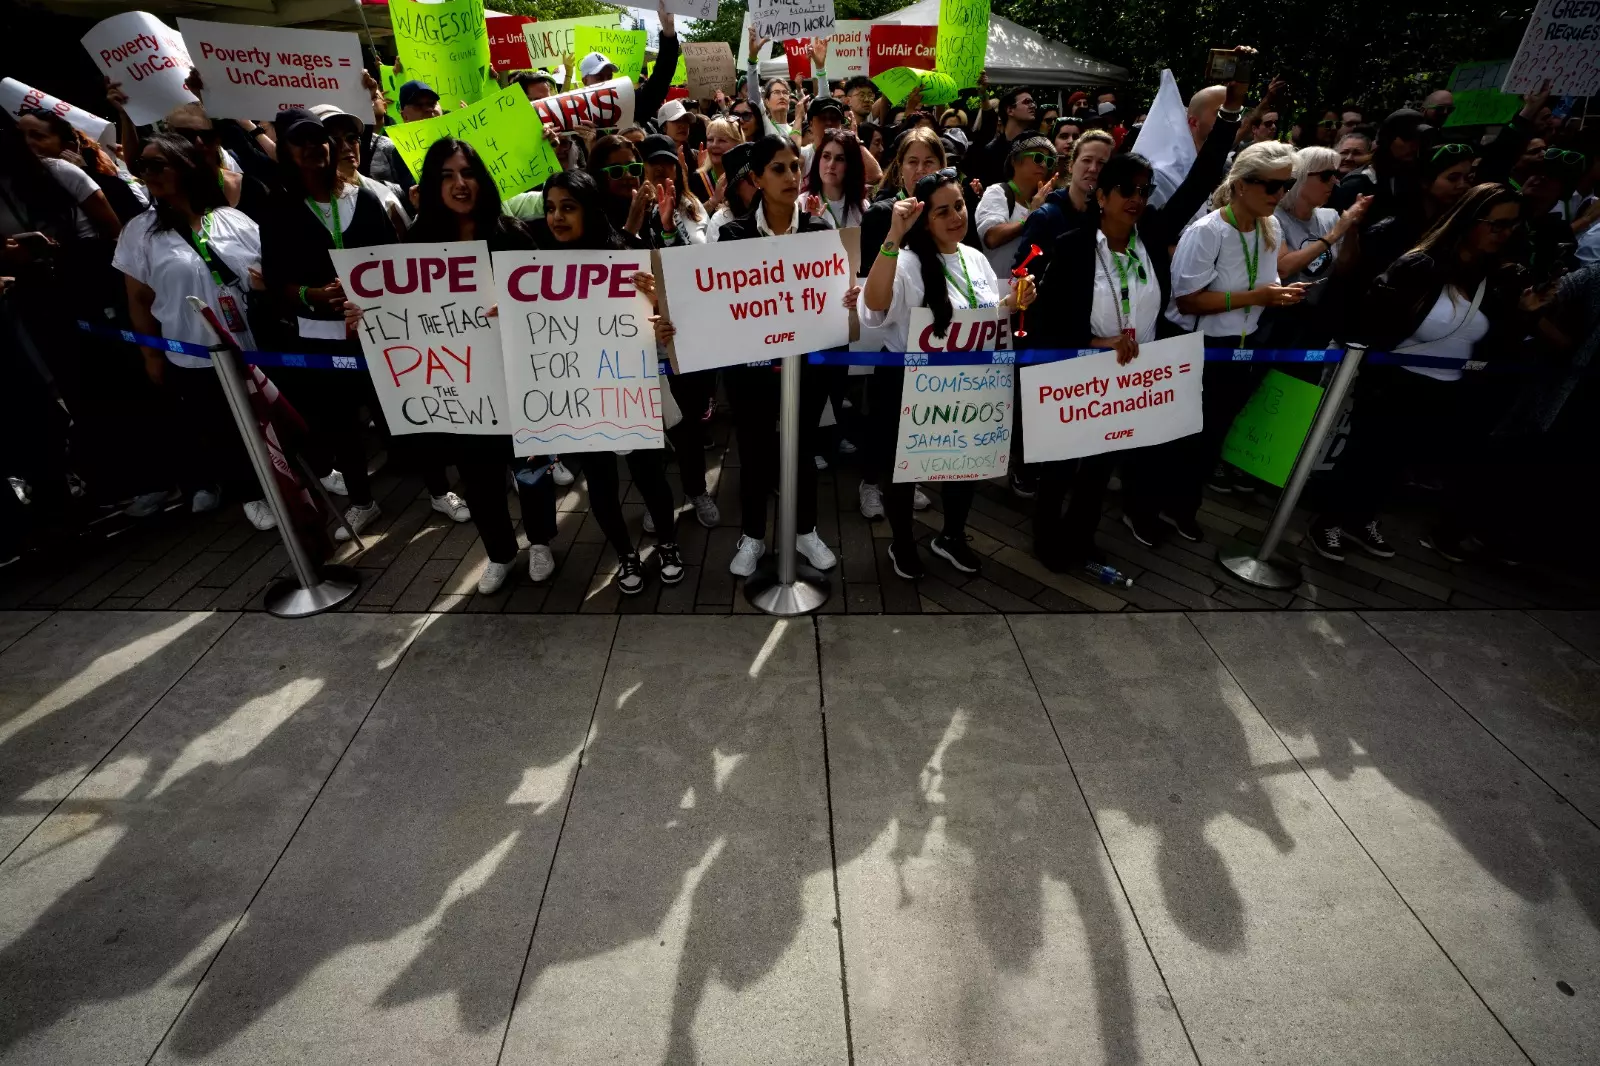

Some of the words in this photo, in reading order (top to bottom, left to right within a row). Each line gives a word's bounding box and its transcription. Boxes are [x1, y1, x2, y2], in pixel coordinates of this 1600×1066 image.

[391, 5, 460, 42] WAGES
[789, 4, 826, 15] MONTH
[600, 31, 638, 45] TRAVAIL
[758, 21, 801, 39] UNPAID
[804, 16, 835, 32] WORK
[100, 34, 159, 68] Poverty
[200, 42, 271, 67] Poverty
[277, 52, 333, 71] wages
[338, 58, 351, 67] =
[836, 46, 863, 57] won't
[877, 43, 913, 57] UnfAir
[226, 67, 340, 90] UnCanadian
[396, 129, 431, 153] WE
[439, 108, 488, 139] HAVE
[495, 94, 515, 112] TO
[350, 255, 477, 298] CUPE
[507, 263, 639, 302] CUPE
[695, 259, 785, 293] Unpaid
[793, 253, 845, 281] work
[729, 291, 794, 320] won't
[801, 288, 827, 314] fly
[362, 306, 410, 344] FLY
[418, 314, 444, 335] THE
[441, 302, 492, 337] FLAG
[526, 311, 579, 346] PAY
[598, 314, 639, 338] US
[764, 331, 795, 345] CUPE
[918, 319, 1008, 353] CUPE
[383, 345, 472, 388] PAY
[530, 351, 581, 381] FOR
[597, 348, 657, 380] ALL
[433, 386, 459, 397] THE
[1039, 376, 1110, 404] Poverty
[1116, 365, 1172, 388] wages
[1179, 363, 1191, 373] =
[402, 395, 499, 426] CREW!
[523, 388, 591, 422] OUR
[593, 386, 663, 419] TIME
[912, 400, 1004, 426] UNIDOS
[1060, 388, 1174, 424] UnCanadian
[906, 429, 968, 450] JAMAIS
[974, 424, 1010, 447] SERÃO
[1104, 428, 1134, 441] CUPE
